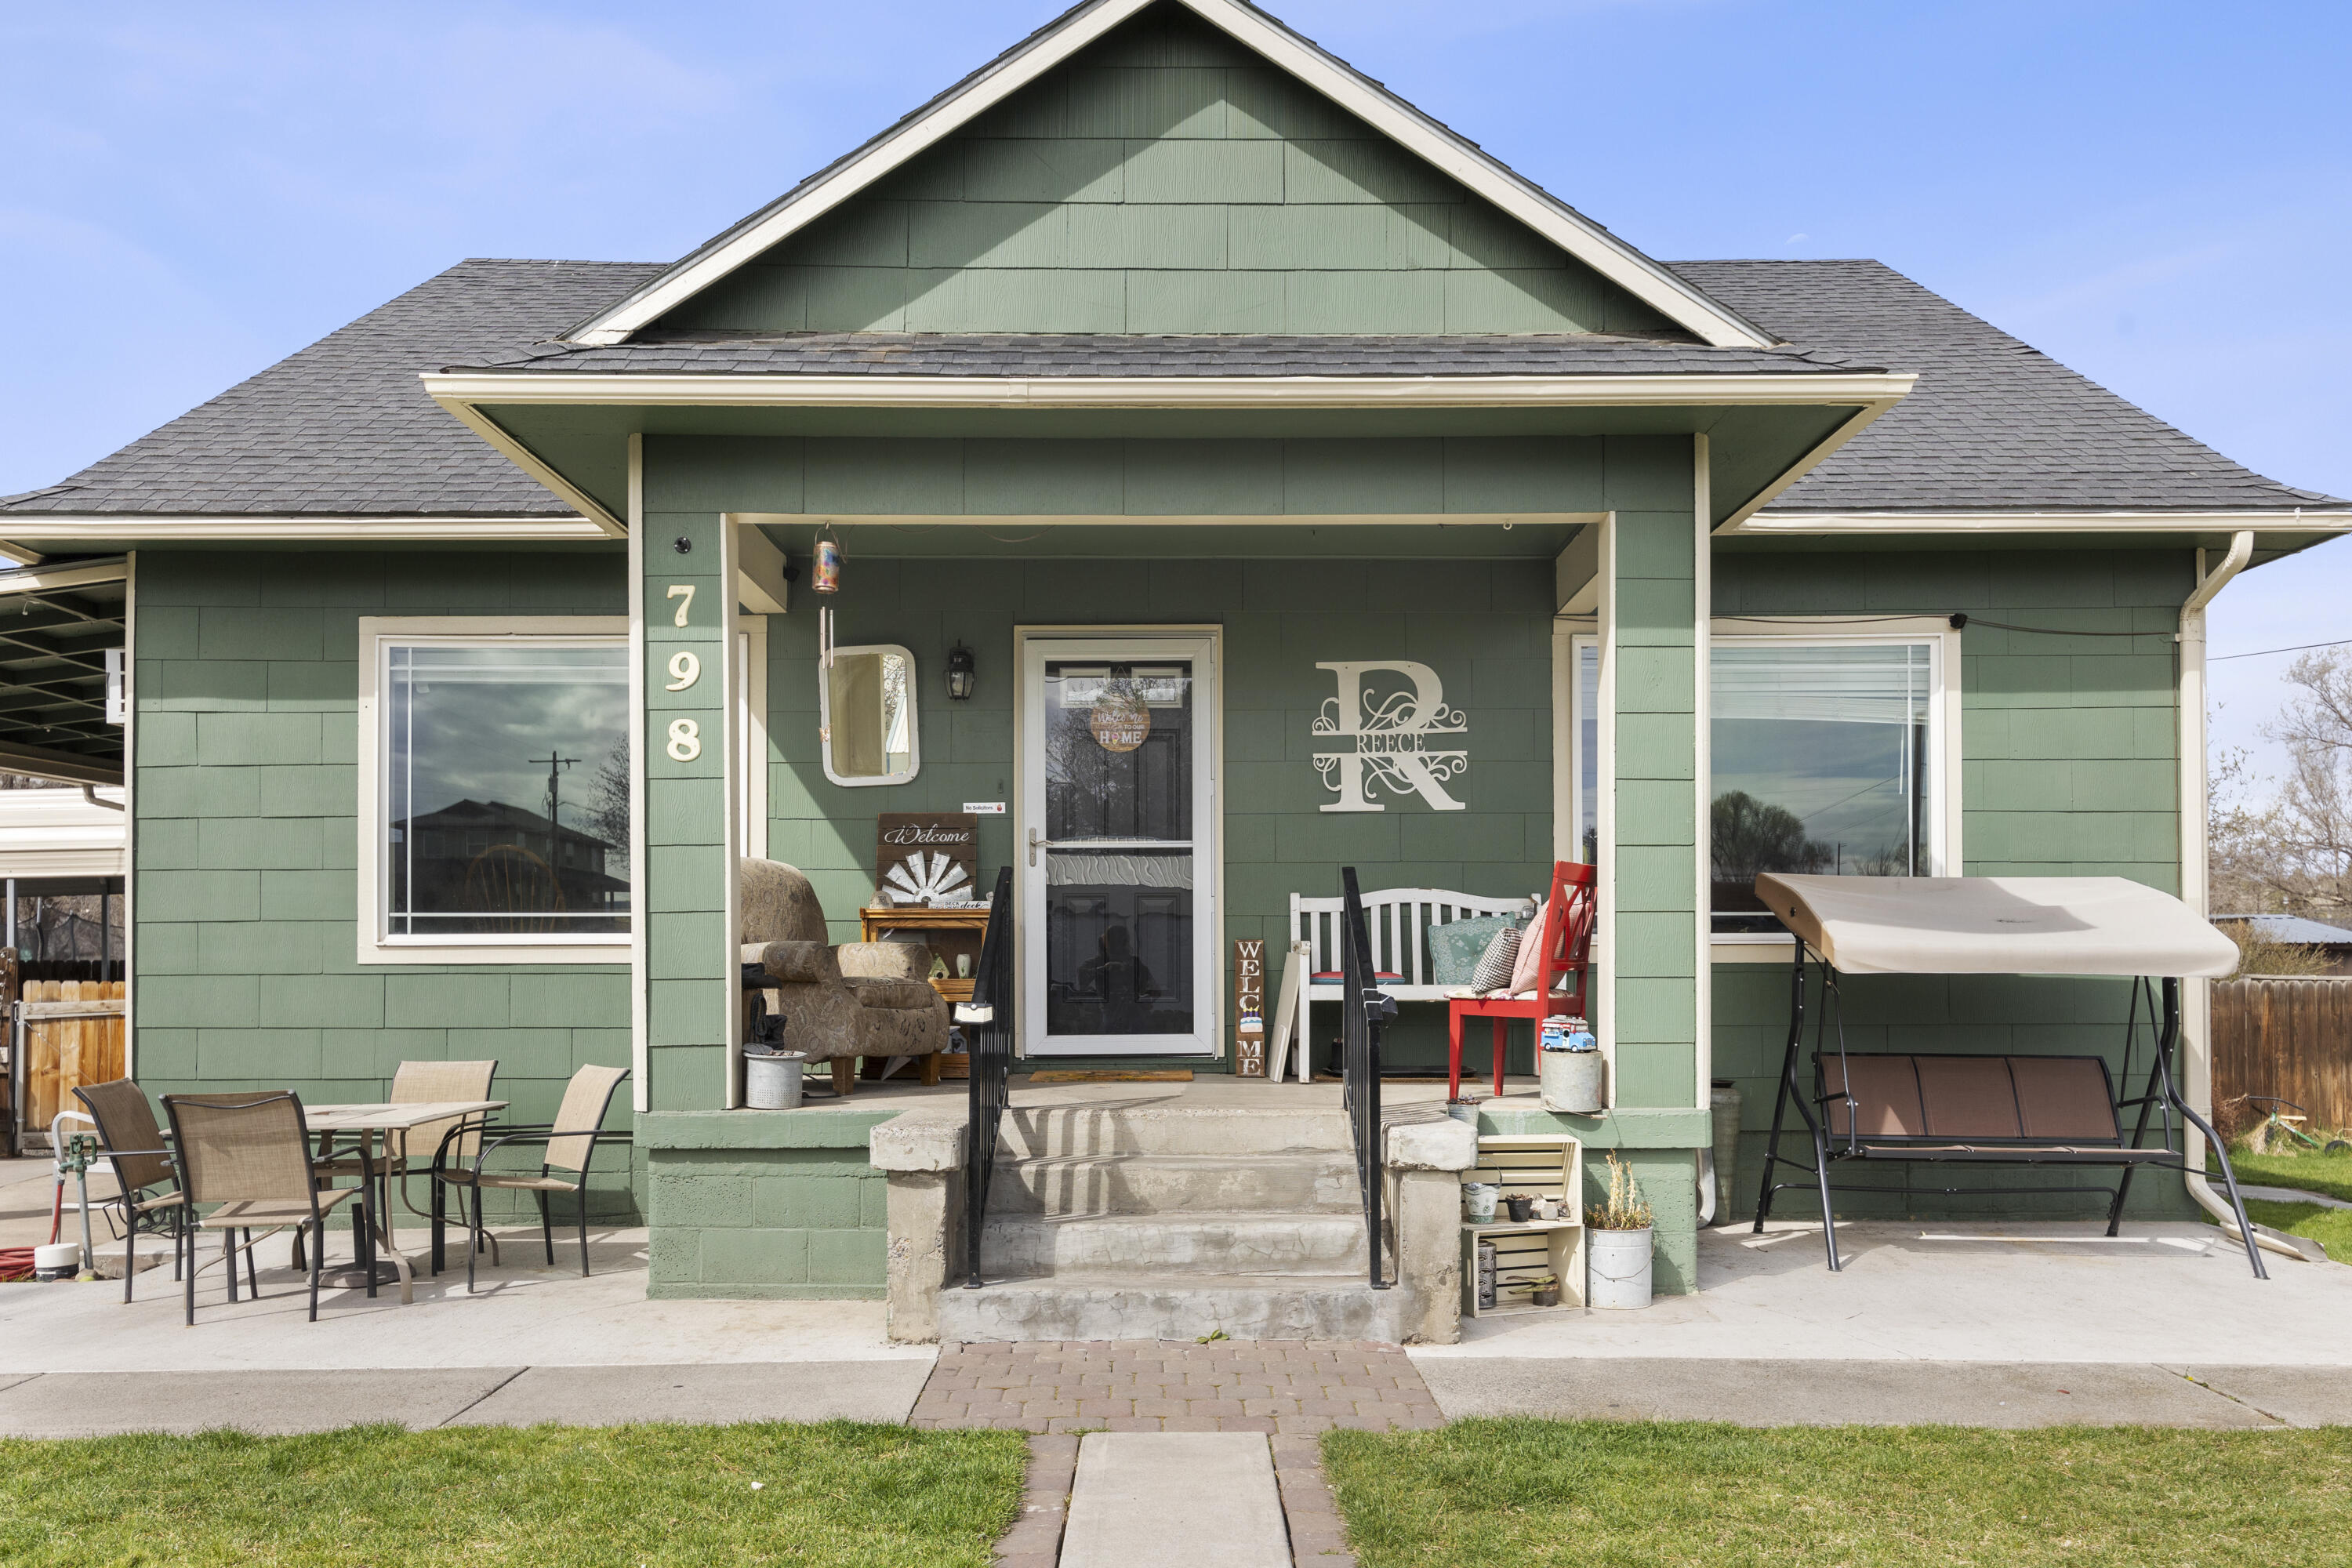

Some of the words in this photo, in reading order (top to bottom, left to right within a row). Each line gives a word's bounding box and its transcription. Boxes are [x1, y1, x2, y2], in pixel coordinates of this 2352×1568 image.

[666, 584, 702, 763] 798
[1099, 731, 1142, 744] HME
[1312, 660, 1468, 812] R
[1356, 734, 1426, 753] REECE
[884, 823, 970, 844] Welcome
[960, 901, 987, 909] deck
[1236, 942, 1263, 1076] WELCME
